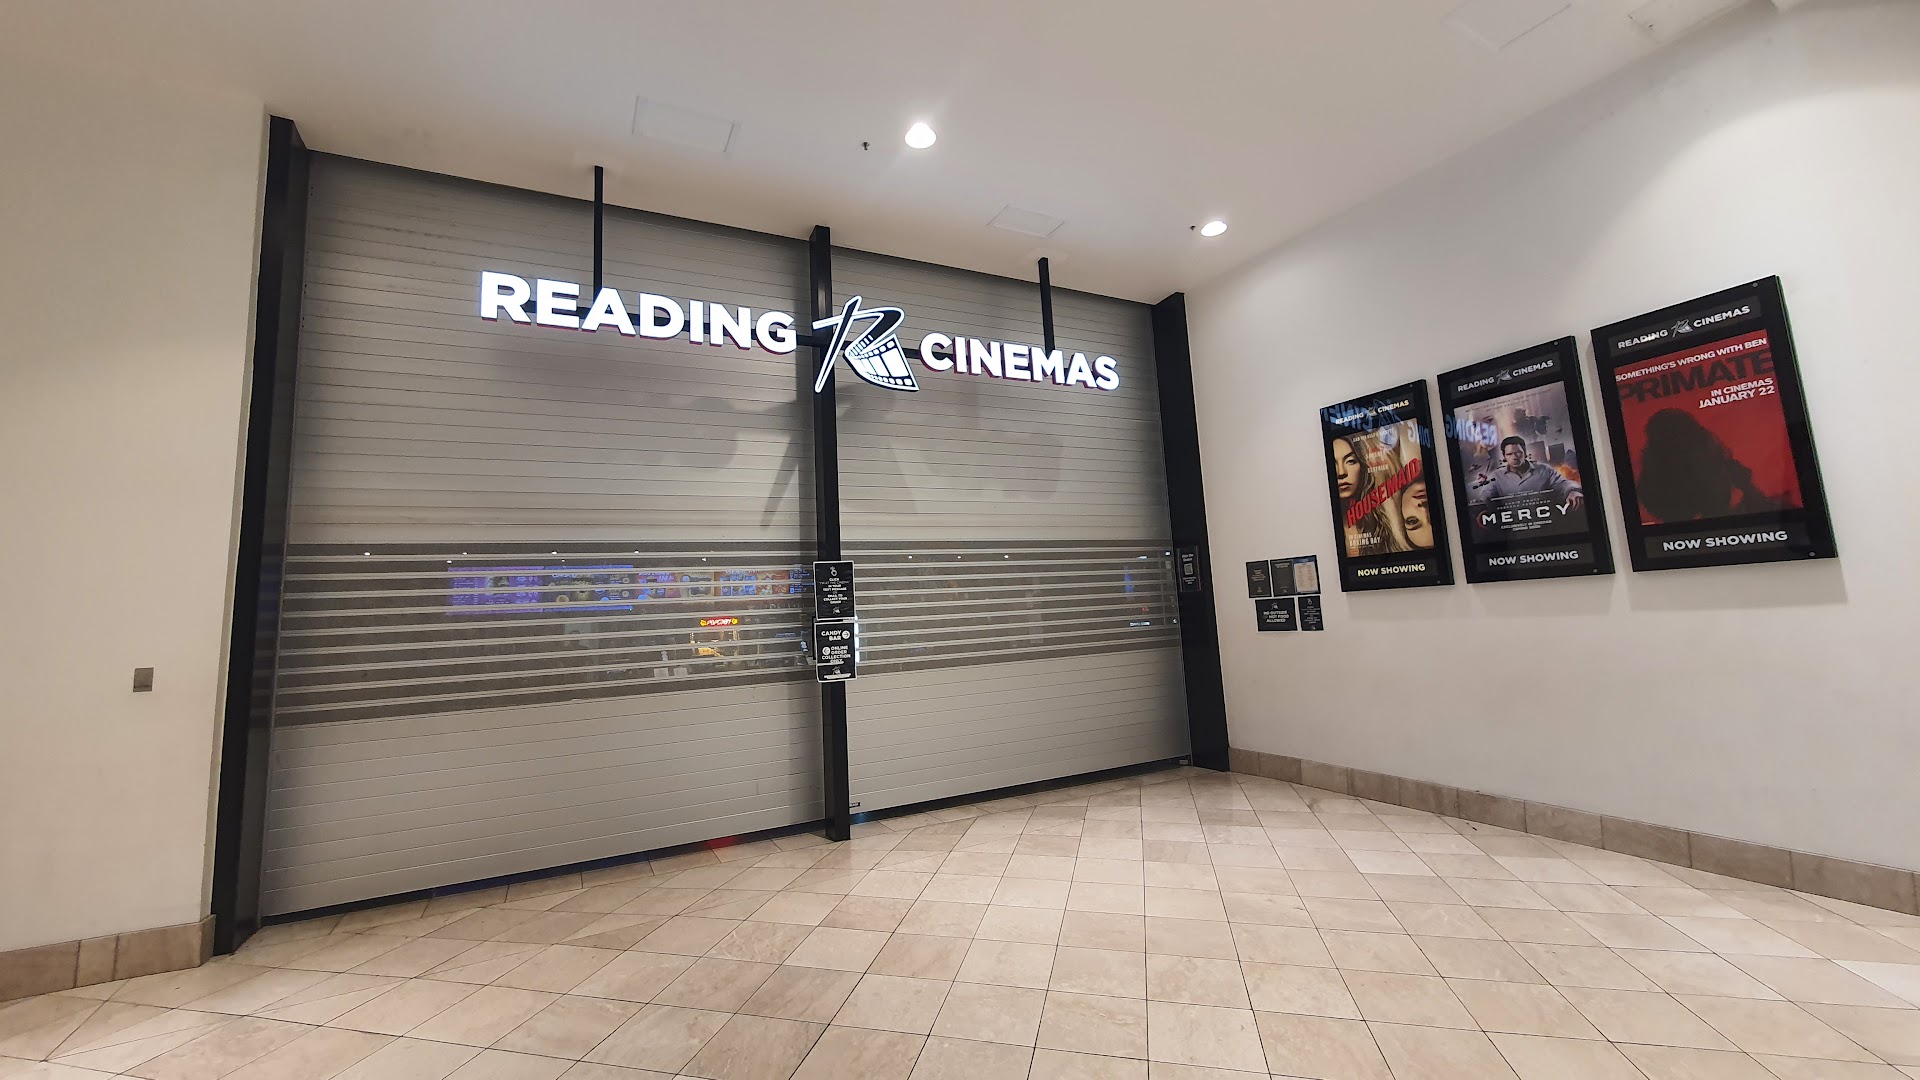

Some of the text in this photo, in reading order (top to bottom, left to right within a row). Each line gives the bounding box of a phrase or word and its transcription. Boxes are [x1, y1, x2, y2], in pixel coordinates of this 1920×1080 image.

[480, 270, 798, 354] READING
[919, 332, 1121, 392] CINEMAS
[1618, 305, 1751, 349] READING CINEMAS
[1615, 337, 1768, 382] SOMETHING'S WRONG WITH BEN
[1457, 359, 1554, 393] READING CINEMAS
[1617, 351, 1776, 403] PRIMATE
[1710, 376, 1774, 397] IN CINEMAS
[1698, 385, 1776, 409] JANUARY 22
[1335, 399, 1410, 425] READING CINEMAS
[1346, 457, 1421, 528] HOUSEMAID
[1481, 502, 1572, 526] MERCY
[1663, 530, 1789, 552] NOW SHOWING
[1357, 563, 1426, 577] NOW SHOWING
[1488, 550, 1579, 567] NOW SHOWING
